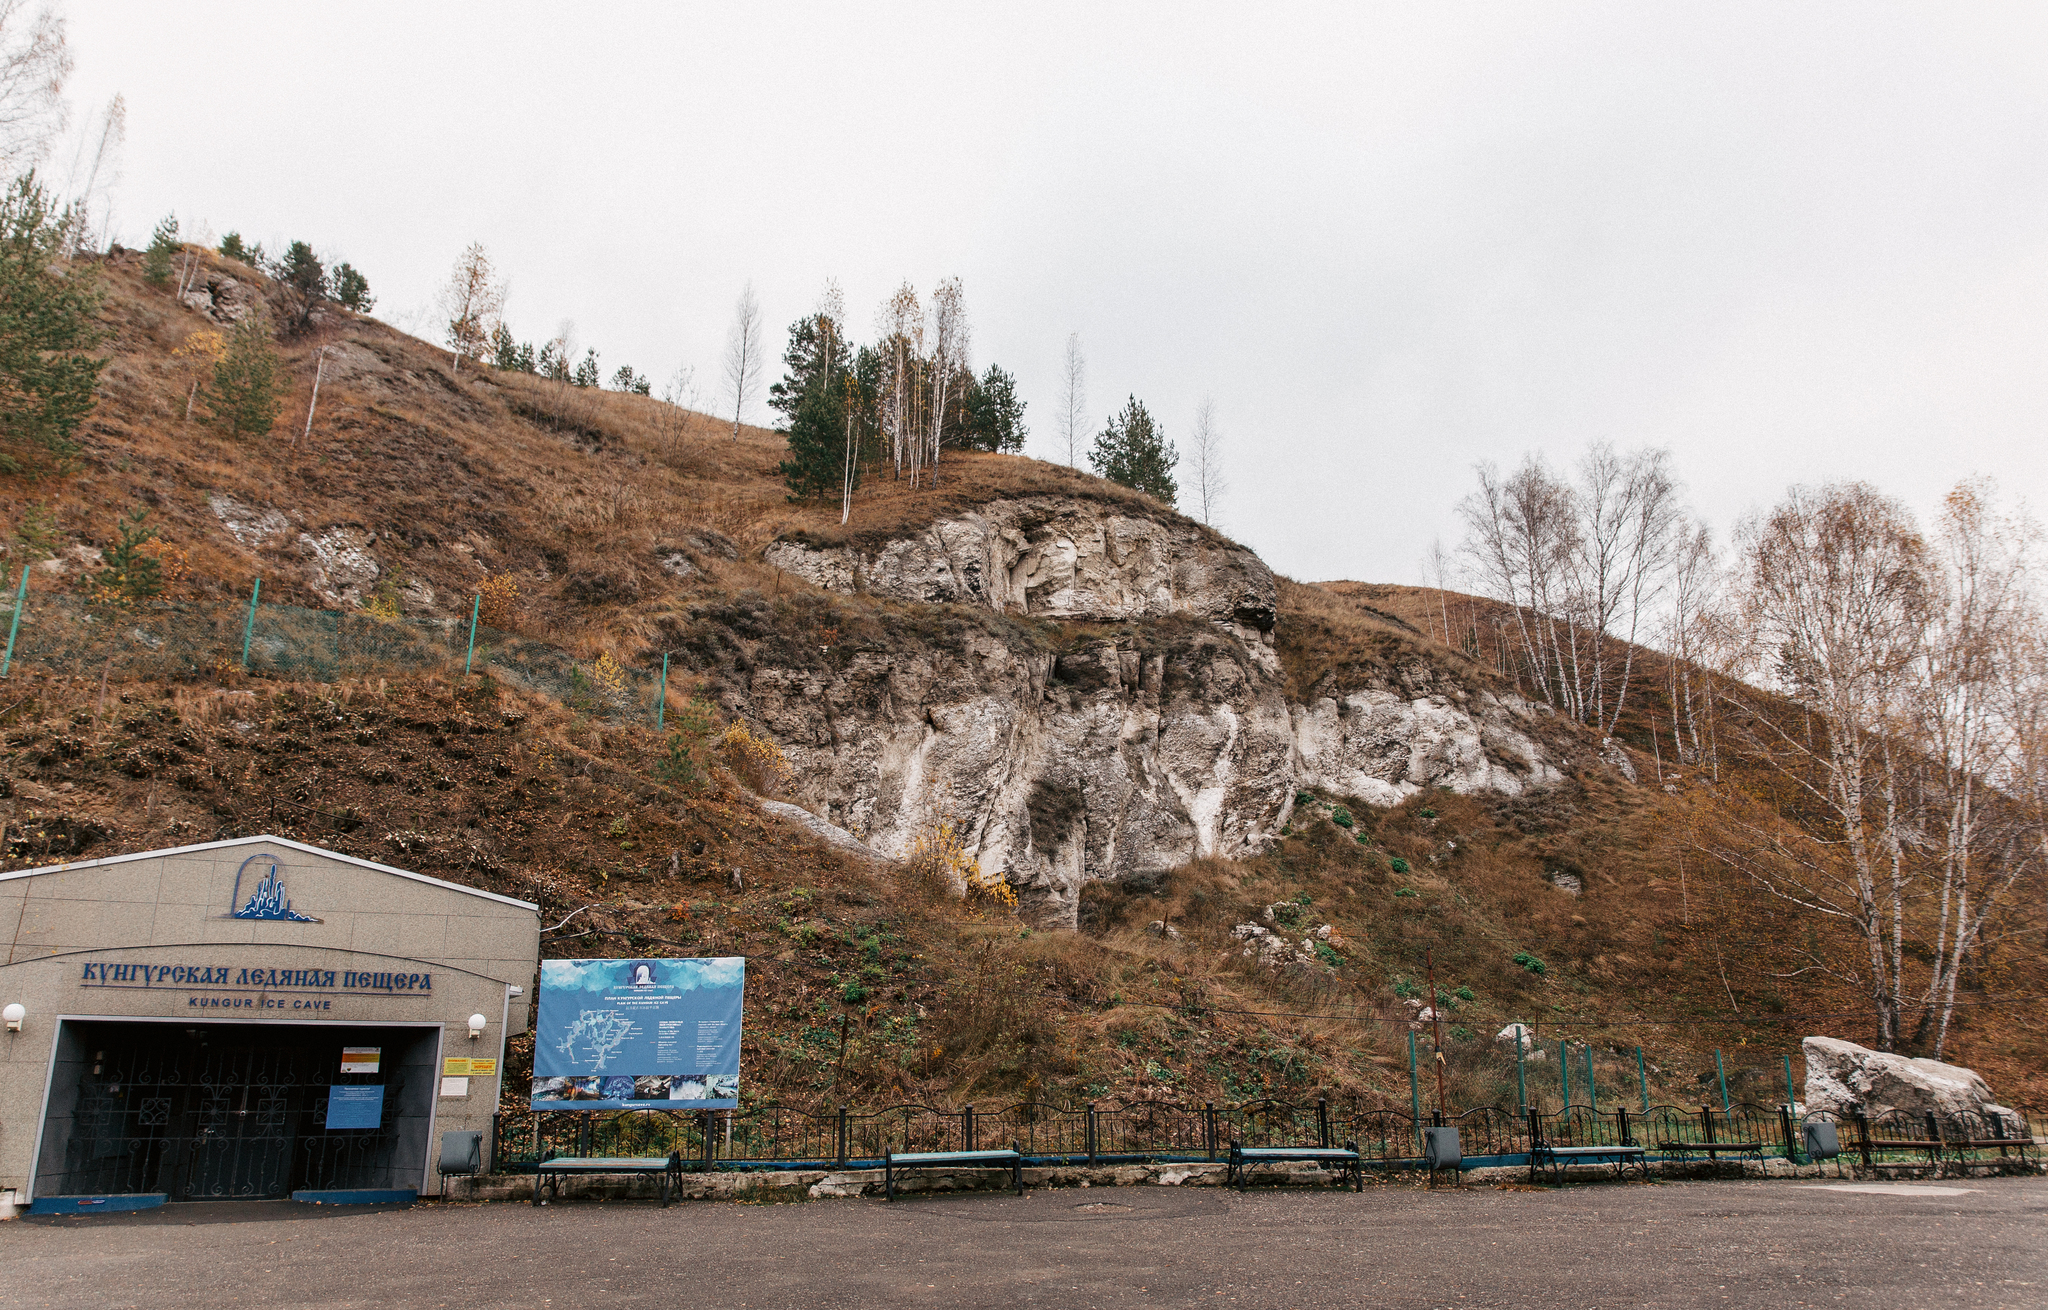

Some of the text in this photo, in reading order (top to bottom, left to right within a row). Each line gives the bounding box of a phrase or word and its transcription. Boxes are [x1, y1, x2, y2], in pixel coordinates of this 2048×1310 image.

[82, 963, 432, 992] КУНГУРСКАЯ ЛЕДЯНАЯ ПЕЩЕРА
[189, 997, 331, 1010] KUNGUR ICE CAVE
